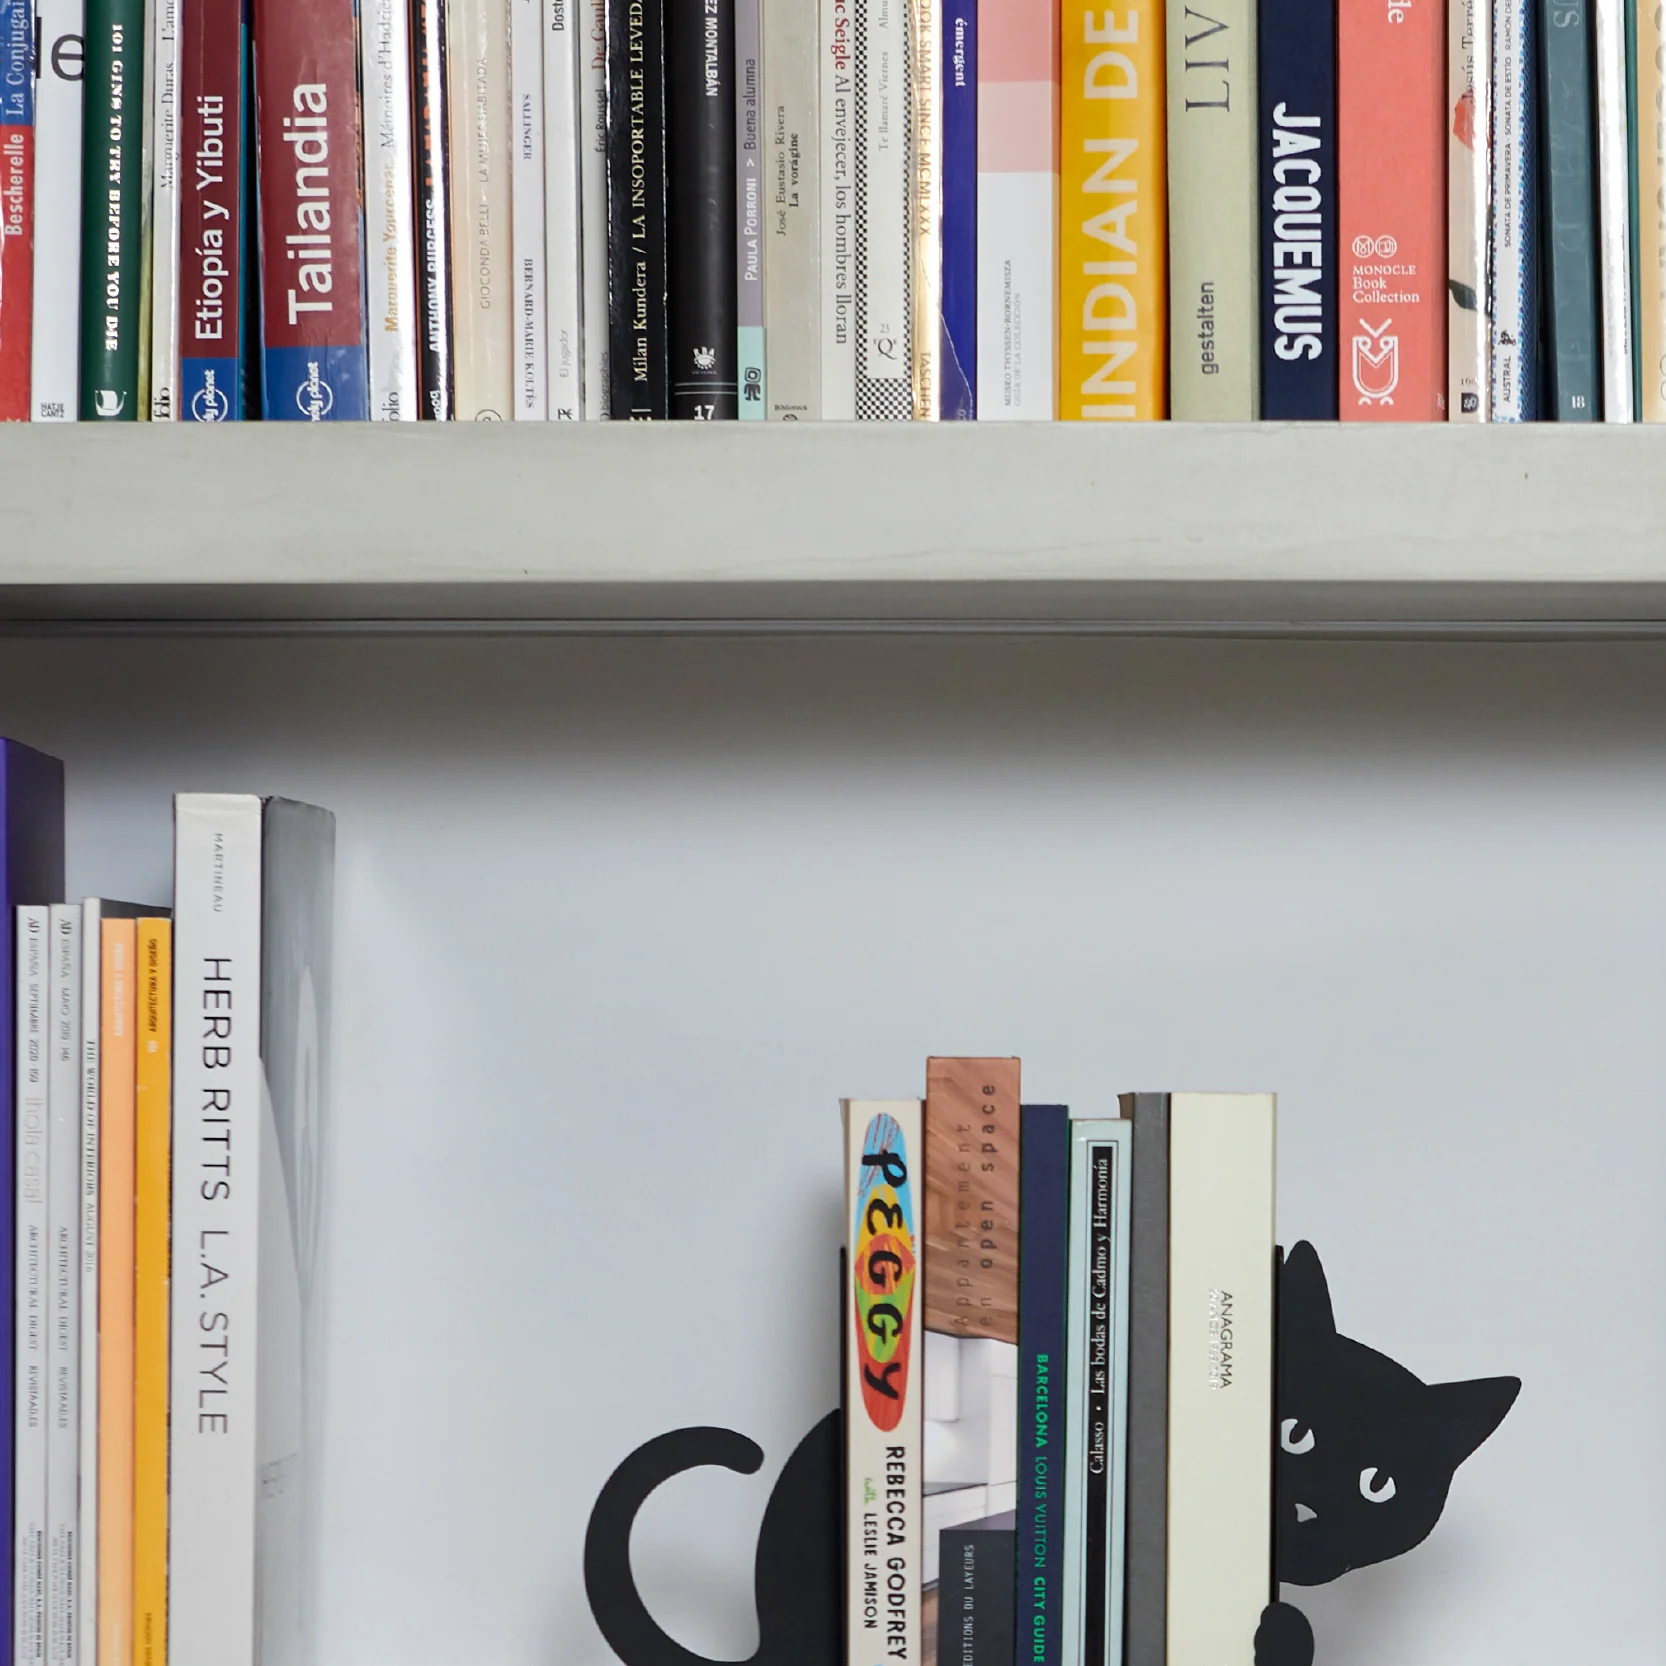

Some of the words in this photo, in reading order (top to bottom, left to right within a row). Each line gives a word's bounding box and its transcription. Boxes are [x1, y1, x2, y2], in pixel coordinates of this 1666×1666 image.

[111, 24, 123, 53] 101
[111, 60, 123, 110] GINS
[742, 59, 755, 106] alumna
[110, 116, 122, 140] TO
[196, 95, 222, 190] Yibuti
[630, 69, 645, 207] INSOPORTABLE
[743, 110, 756, 150] Buena
[6, 134, 25, 235] Bescherelle
[109, 146, 121, 184] TRY
[107, 190, 121, 266] BEFORE
[202, 201, 229, 219] y
[283, 83, 332, 324] Tailandia
[632, 215, 646, 239] LA
[743, 178, 756, 235] PORRONI
[1272, 103, 1323, 360] JACQUEMUS
[106, 272, 120, 310] YOU
[195, 229, 228, 340] Etiopía
[745, 239, 757, 281] PAULA
[1080, 138, 1139, 417] INDIAN
[1352, 279, 1387, 288] Book
[1353, 265, 1416, 275] MONOCLE
[632, 262, 647, 330] Kundera
[1352, 293, 1420, 302] Collection
[105, 316, 119, 351] DIE
[633, 337, 648, 382] Milan
[1198, 282, 1219, 374] gestalten
[202, 958, 231, 1069] HERB
[201, 1088, 231, 1200] RITTS
[199, 1230, 229, 1299] L.A.
[861, 1148, 909, 1401] PEGGY
[1221, 1291, 1233, 1388] ANAGRAMA
[199, 1312, 228, 1434] STYLE
[1035, 1354, 1048, 1447] BARCELONA
[886, 1447, 905, 1546] REBECCA
[1035, 1457, 1047, 1499] LOUIS
[864, 1513, 878, 1556] LESLIE
[1034, 1504, 1047, 1567] VUITTON
[864, 1564, 878, 1628] JAMISON
[887, 1558, 906, 1659] GODFREY
[1033, 1577, 1045, 1610] CITY
[1033, 1615, 1045, 1663] GUIDE
